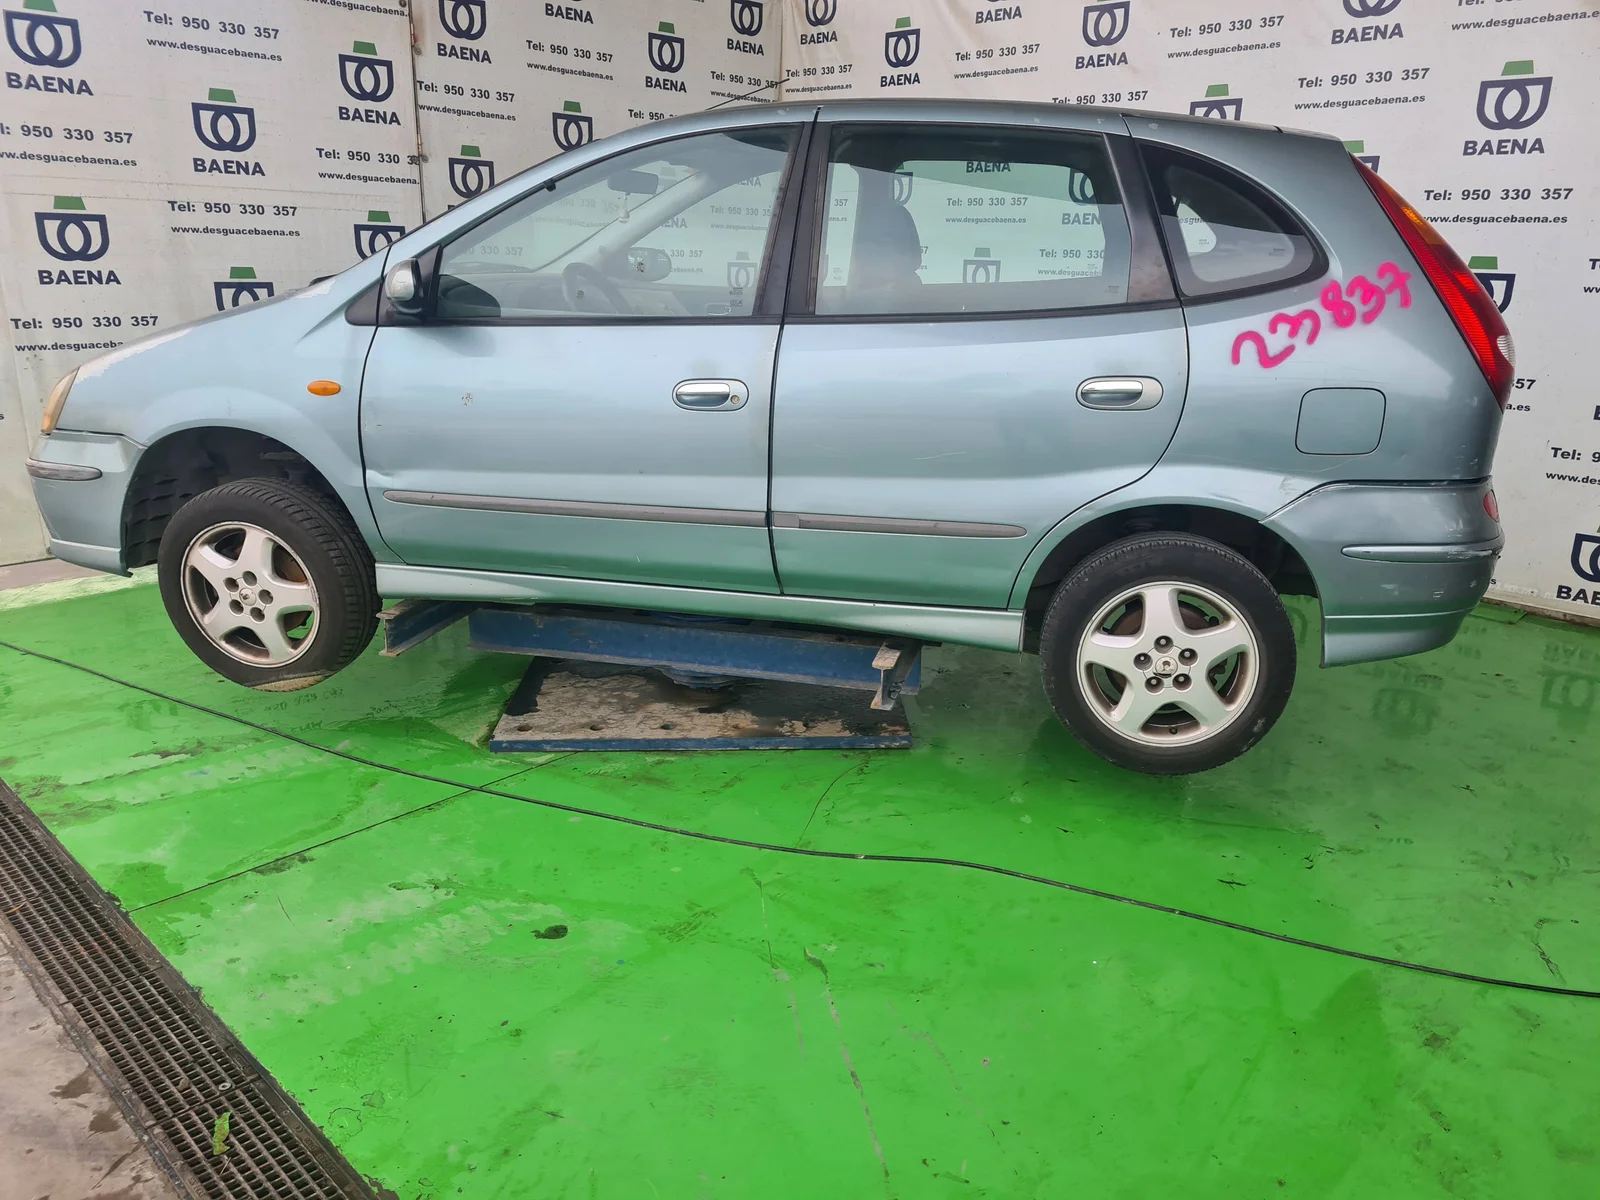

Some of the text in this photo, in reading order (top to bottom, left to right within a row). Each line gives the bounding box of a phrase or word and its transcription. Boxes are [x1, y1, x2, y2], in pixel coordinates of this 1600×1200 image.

[303, 0, 410, 17] w.desguacebaena.
[545, 3, 593, 24] BAENA
[976, 6, 1022, 24] BAENA
[143, 11, 279, 39] Tel: 950 330 357
[1170, 15, 1284, 38] Tel: 950 330 357
[801, 31, 837, 45] BAENA
[1331, 23, 1403, 44] BAENA
[147, 39, 282, 61] www.desguacebaena.es
[437, 43, 491, 64] BAENA
[526, 40, 613, 62] Tel: 950 330 357
[727, 38, 764, 55] BAENA
[956, 44, 1040, 61] Tel: 950 330 357
[1168, 42, 1280, 58] www.desguacebaena.es
[1076, 52, 1128, 69] BAENA
[527, 63, 613, 80] www.desguacebaena.es
[803, 68, 817, 76] 950
[821, 66, 834, 75] 330
[839, 64, 852, 73] 357
[954, 66, 1038, 79] www.desguacebaena.es
[1298, 68, 1430, 88] Tel: 950 330 357
[6, 72, 93, 96] BAENA
[646, 76, 687, 93] BAENA
[711, 71, 725, 81] Tel:
[729, 74, 743, 84] 950
[748, 77, 762, 87] 330
[880, 73, 920, 87] BAENA
[417, 80, 514, 102] Tel: 950 330 357
[785, 84, 852, 93] www.desguacebaena.es
[1076, 94, 1096, 105] 950
[1102, 93, 1121, 103] 330
[1128, 91, 1148, 101] 357
[1295, 96, 1425, 110] www.desguacebaena.es
[339, 106, 401, 125] BAENA
[418, 103, 516, 121] www.desguacebaena.es
[628, 109, 644, 119] Tel:
[649, 111, 664, 120] 950
[21, 125, 53, 138] 950
[63, 128, 94, 141] 330
[104, 131, 132, 143] 357
[1463, 138, 1544, 156] BAENA
[316, 148, 340, 159] Tel:
[348, 151, 370, 161] 950
[378, 153, 400, 164] 330
[193, 158, 265, 176] BAENA
[966, 161, 1011, 173] BAENA
[946, 197, 1028, 206] Tel: 950 330 357
[1424, 188, 1573, 200] Tel: 950 330 357
[167, 201, 297, 216] Tel: 950 330 357
[710, 206, 724, 214] Tel:
[728, 206, 742, 214] 950
[745, 207, 758, 216] 330
[171, 226, 300, 236] www.desguacebaena.es
[670, 250, 684, 258] 330
[688, 250, 703, 258] 357
[1040, 249, 1057, 258] Tel:
[1062, 250, 1081, 258] 950
[38, 270, 121, 285] BAENA
[10, 316, 158, 329] Tel: 950 330 357
[1512, 378, 1536, 390] 57
[1551, 447, 1581, 460] Tel:
